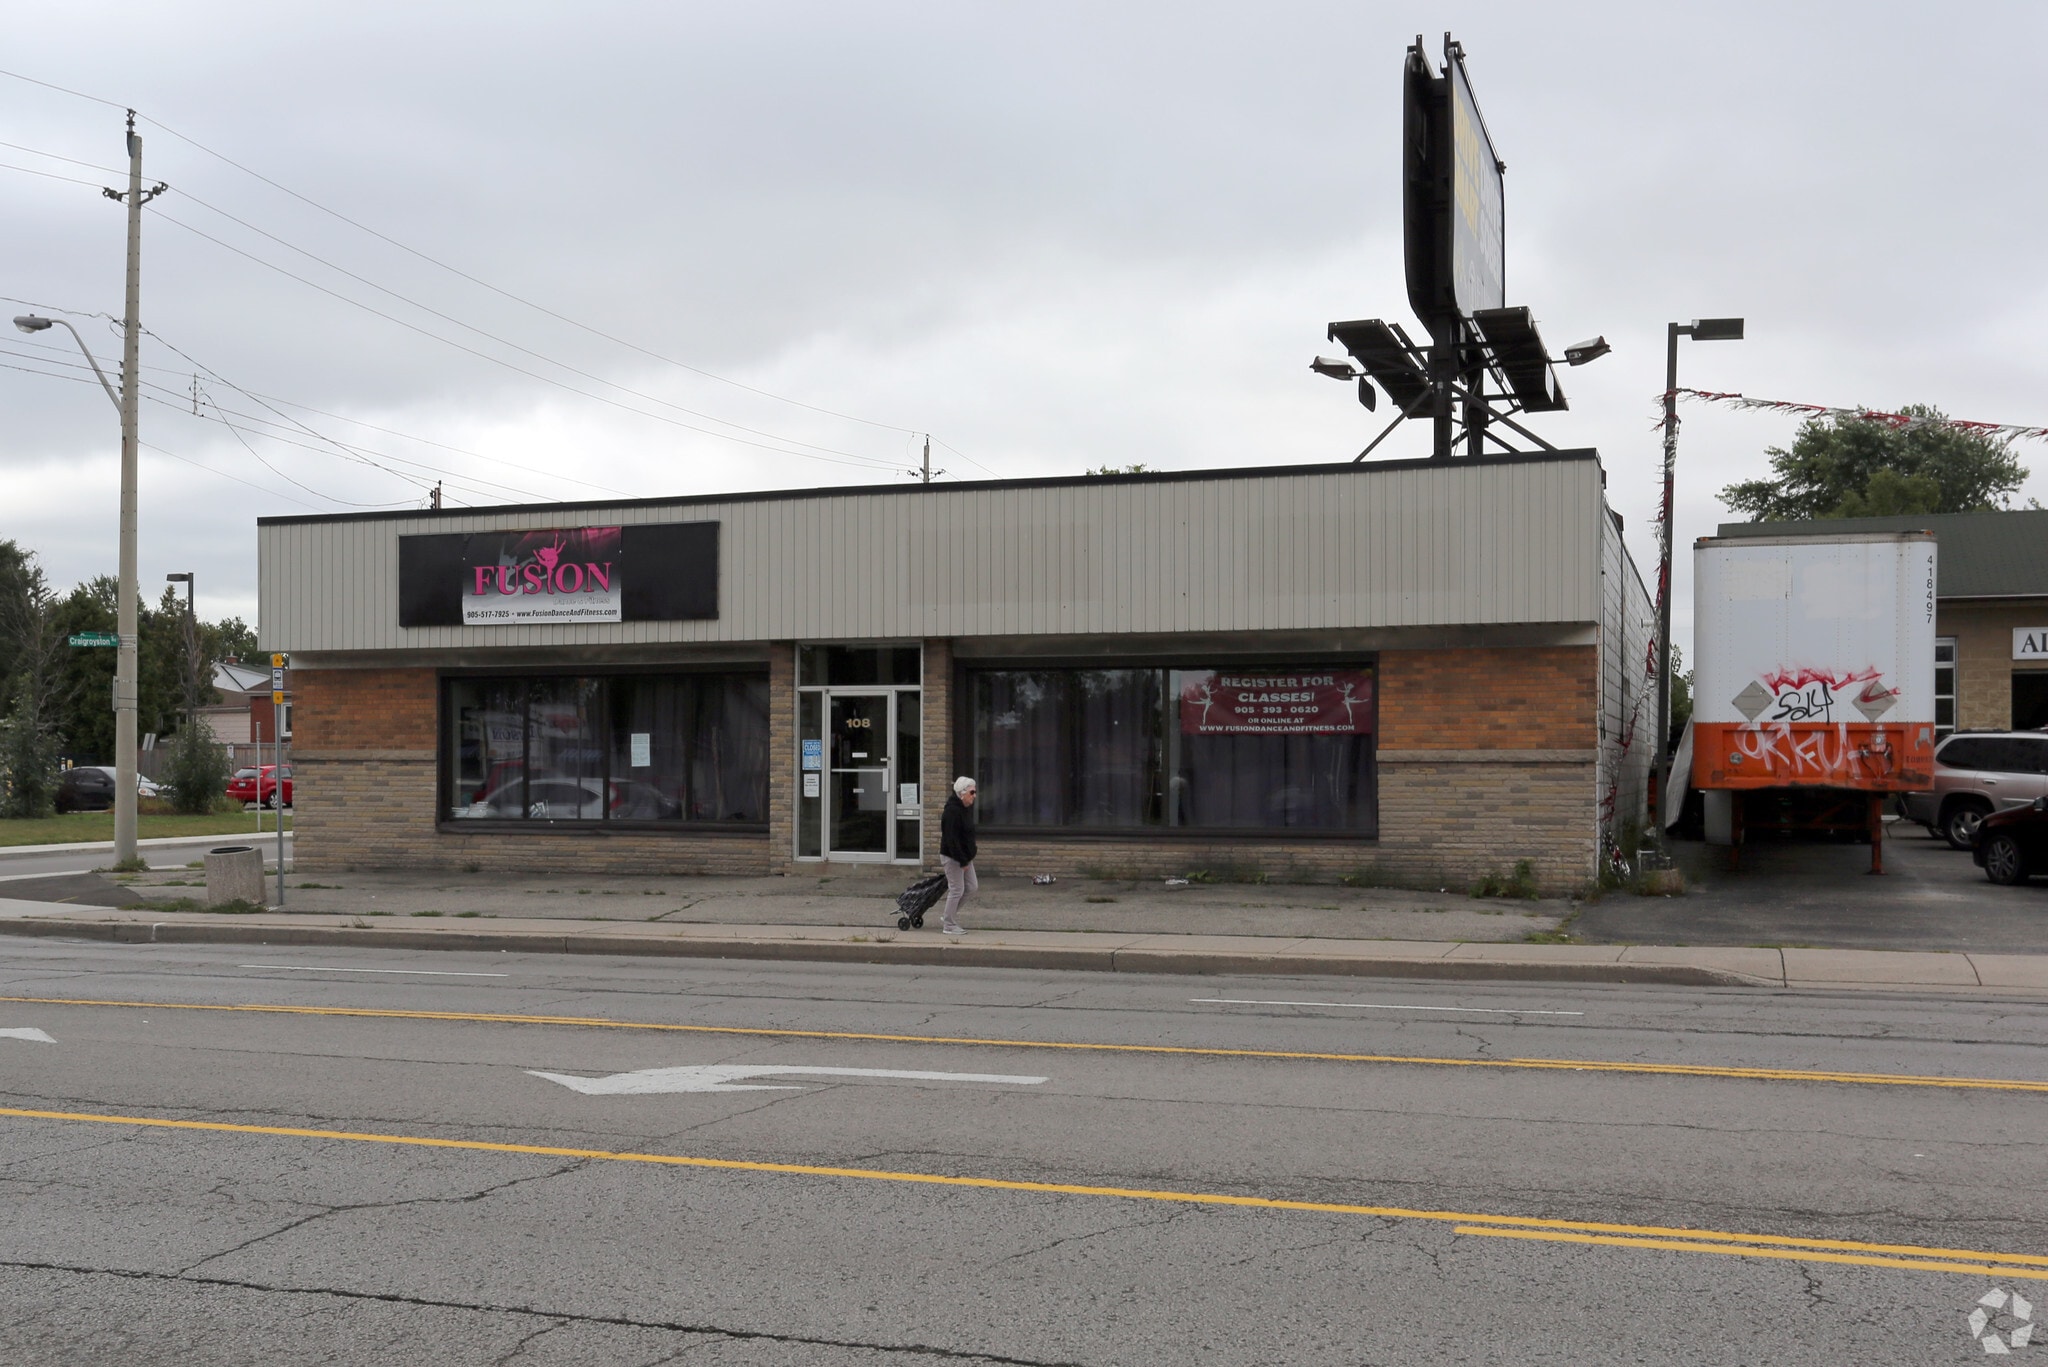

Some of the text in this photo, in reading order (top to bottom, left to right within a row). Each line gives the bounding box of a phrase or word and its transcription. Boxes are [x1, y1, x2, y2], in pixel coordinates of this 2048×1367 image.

[1480, 149, 1503, 247] DRIVE
[1480, 209, 1503, 292] SOBER
[472, 552, 612, 595] FUSION
[467, 608, 617, 619] 905-517-7925 www.FusionDanceAndFitness.com
[69, 636, 111, 647] Craigroyston
[1221, 676, 1334, 688] REGISTER FOR
[1238, 692, 1315, 703] CLASSES!
[1234, 706, 1255, 714] 905
[1262, 706, 1282, 714] 393
[1290, 706, 1319, 714] 0620
[846, 717, 871, 728] 108
